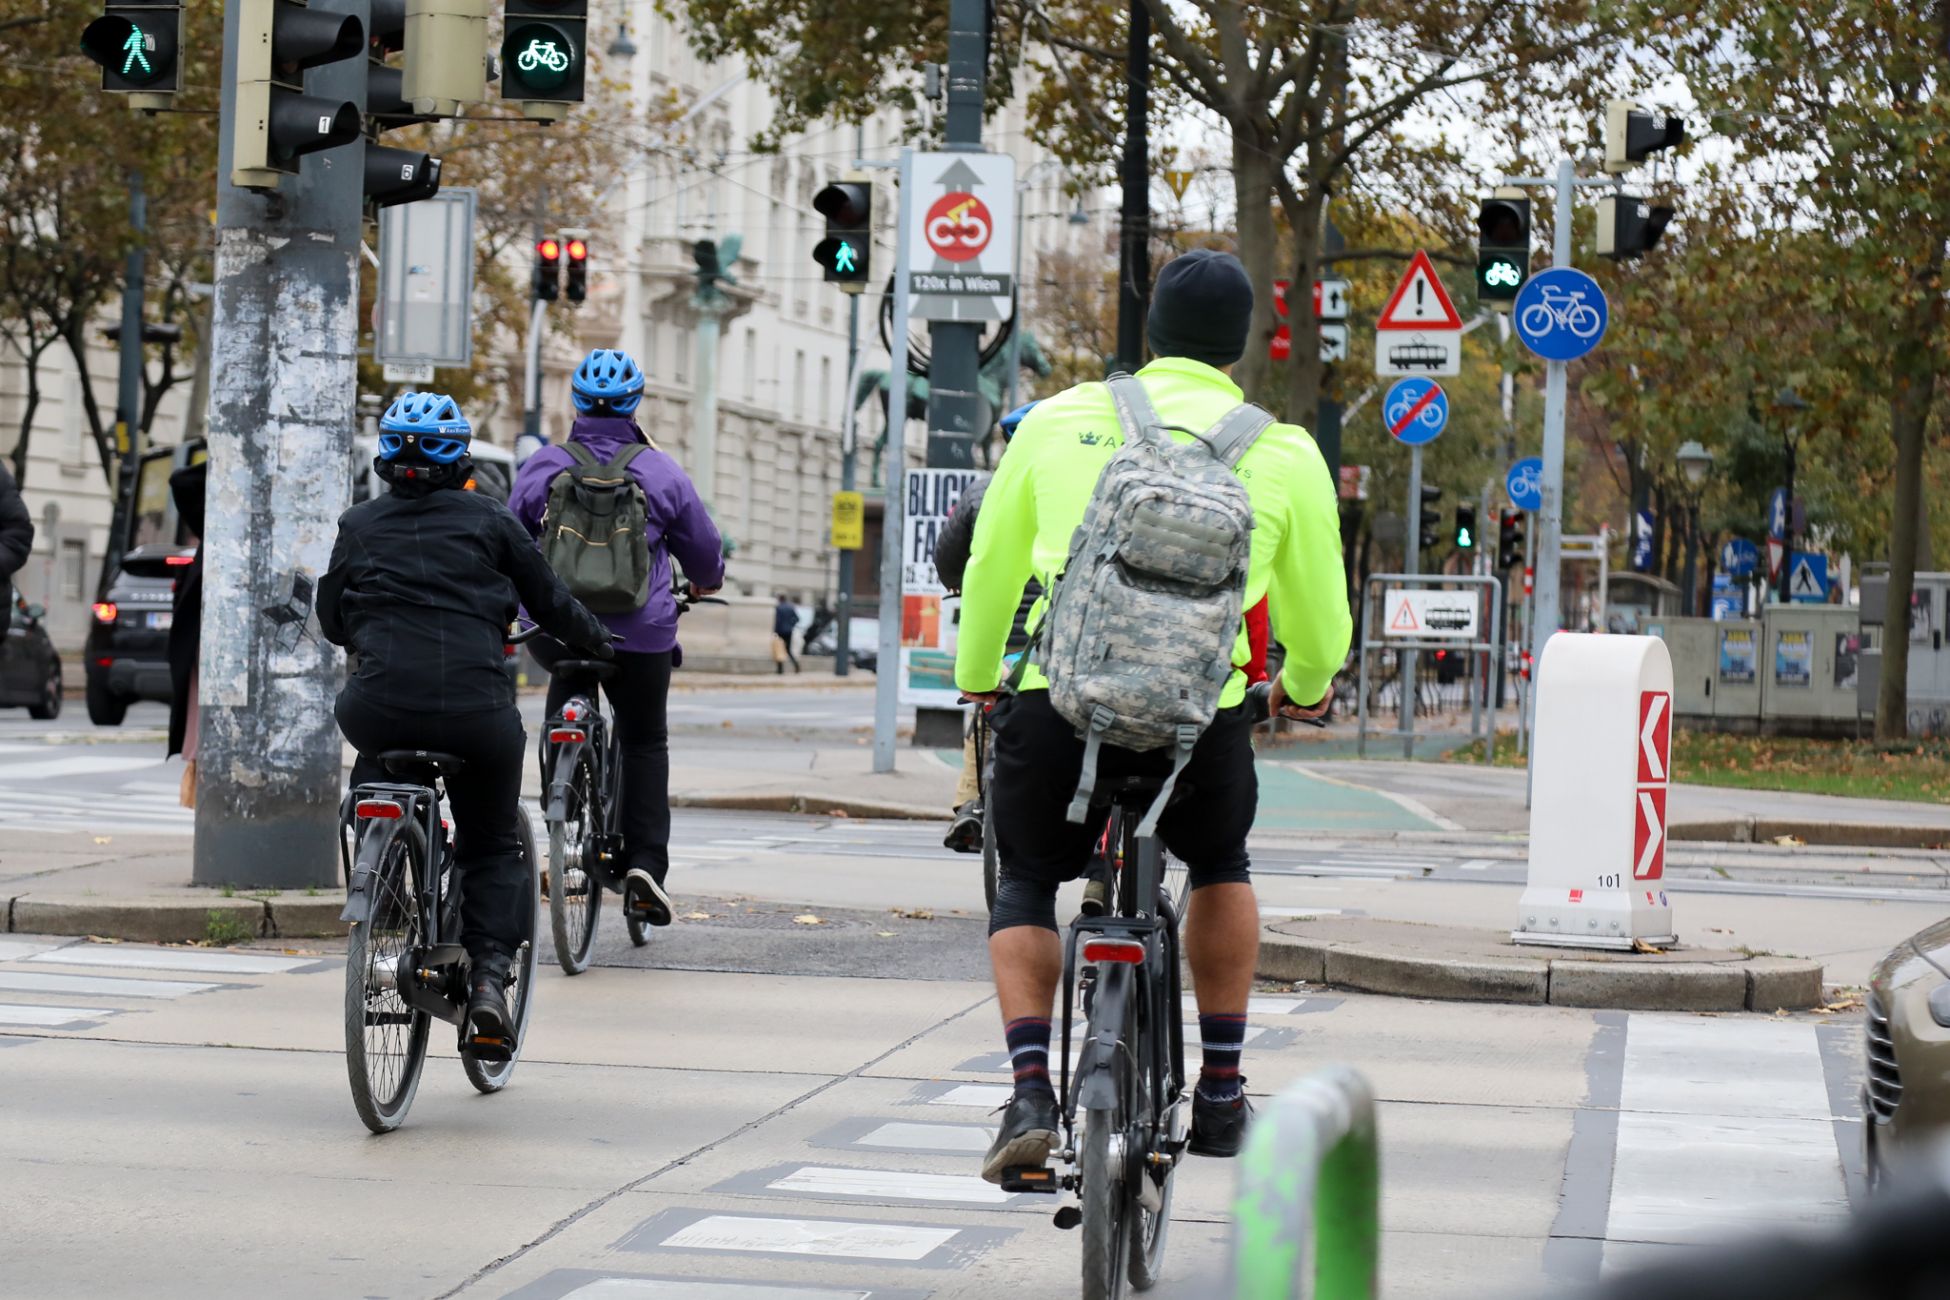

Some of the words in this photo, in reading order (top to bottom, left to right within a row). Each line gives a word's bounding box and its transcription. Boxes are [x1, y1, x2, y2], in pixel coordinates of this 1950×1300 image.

[322, 118, 328, 132] 1
[403, 166, 412, 178] 6
[913, 275, 947, 290] 120x
[949, 275, 963, 290] in
[964, 276, 1000, 292] Wien
[914, 520, 945, 563] FA
[1598, 873, 1620, 888] 101
